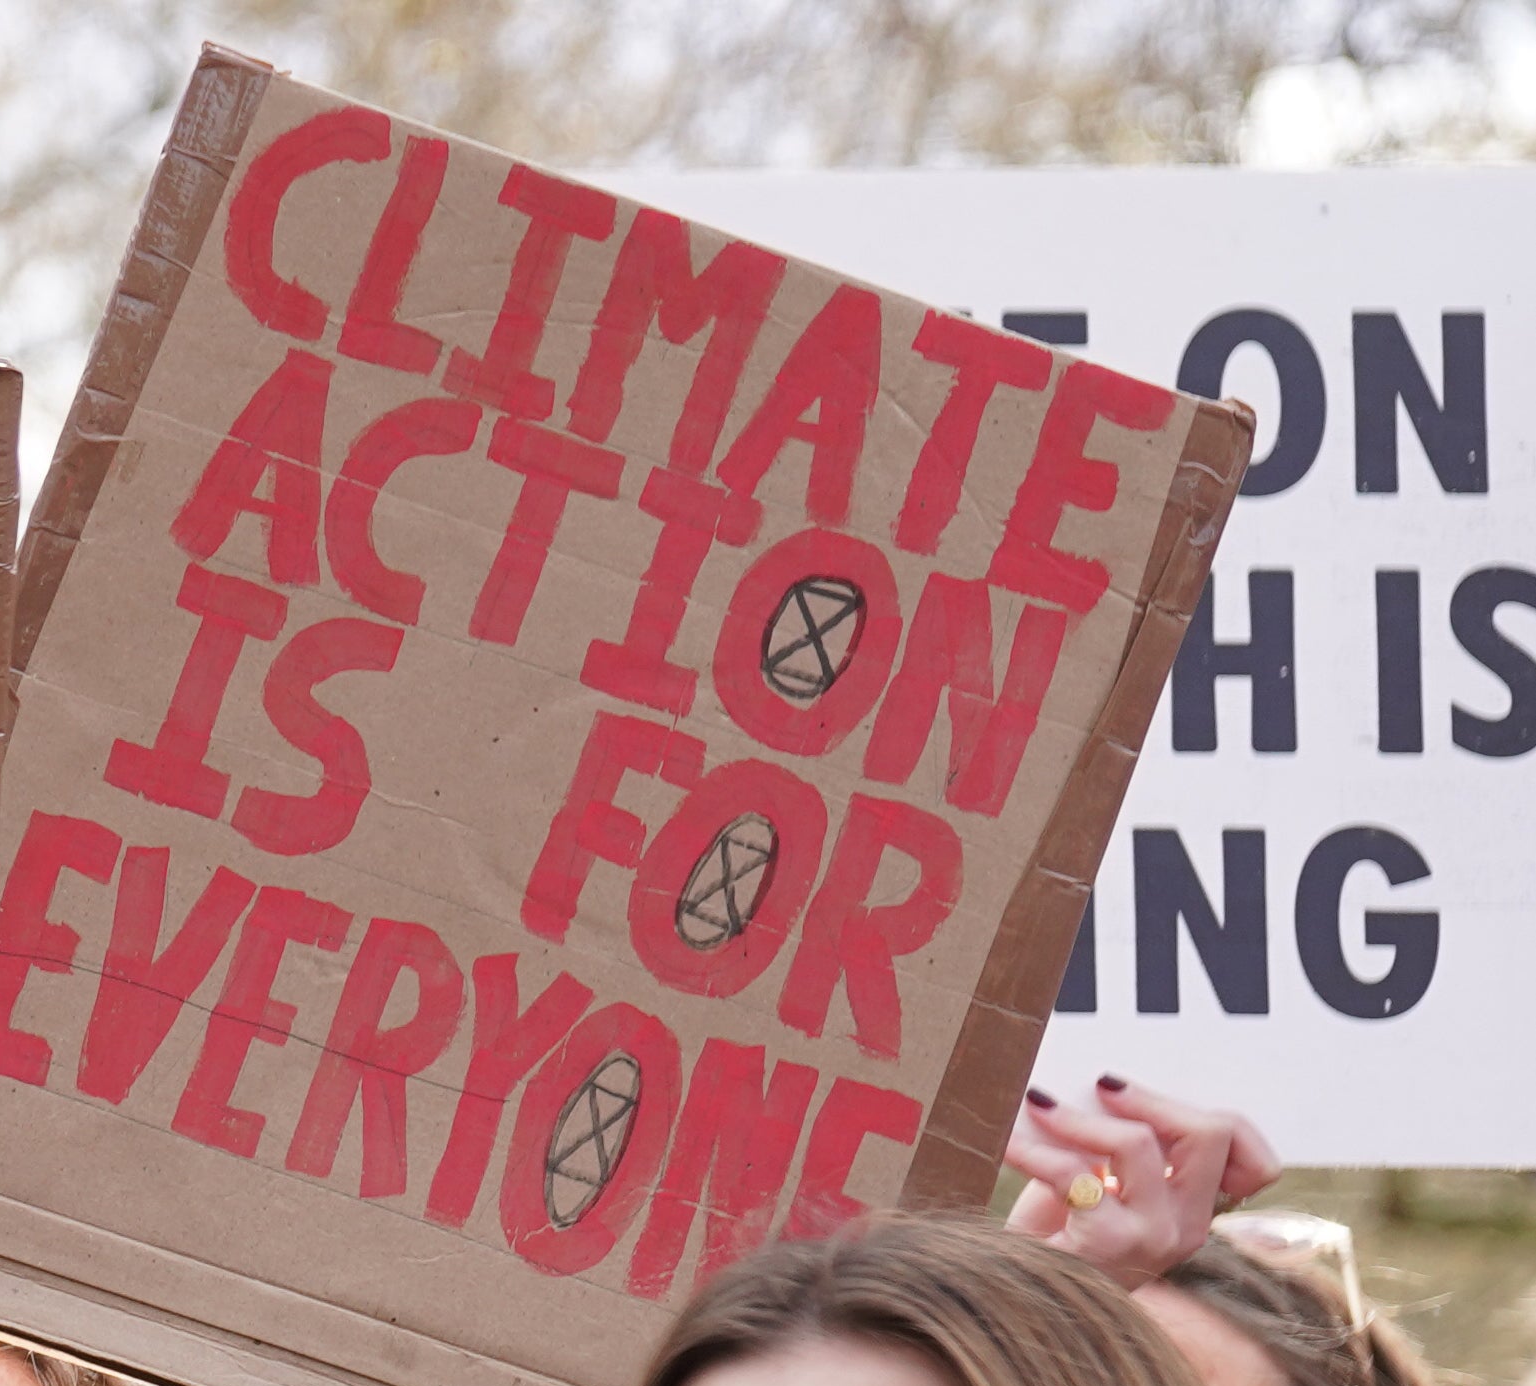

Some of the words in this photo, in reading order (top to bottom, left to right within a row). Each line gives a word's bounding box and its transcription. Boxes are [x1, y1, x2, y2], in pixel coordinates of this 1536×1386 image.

[171, 348, 1069, 817] ACTION
[225, 107, 1179, 618] CLIMATE
[1177, 309, 1489, 498] ON
[104, 562, 405, 856] IS
[521, 711, 962, 1060] FOR
[1375, 566, 1536, 758] IS
